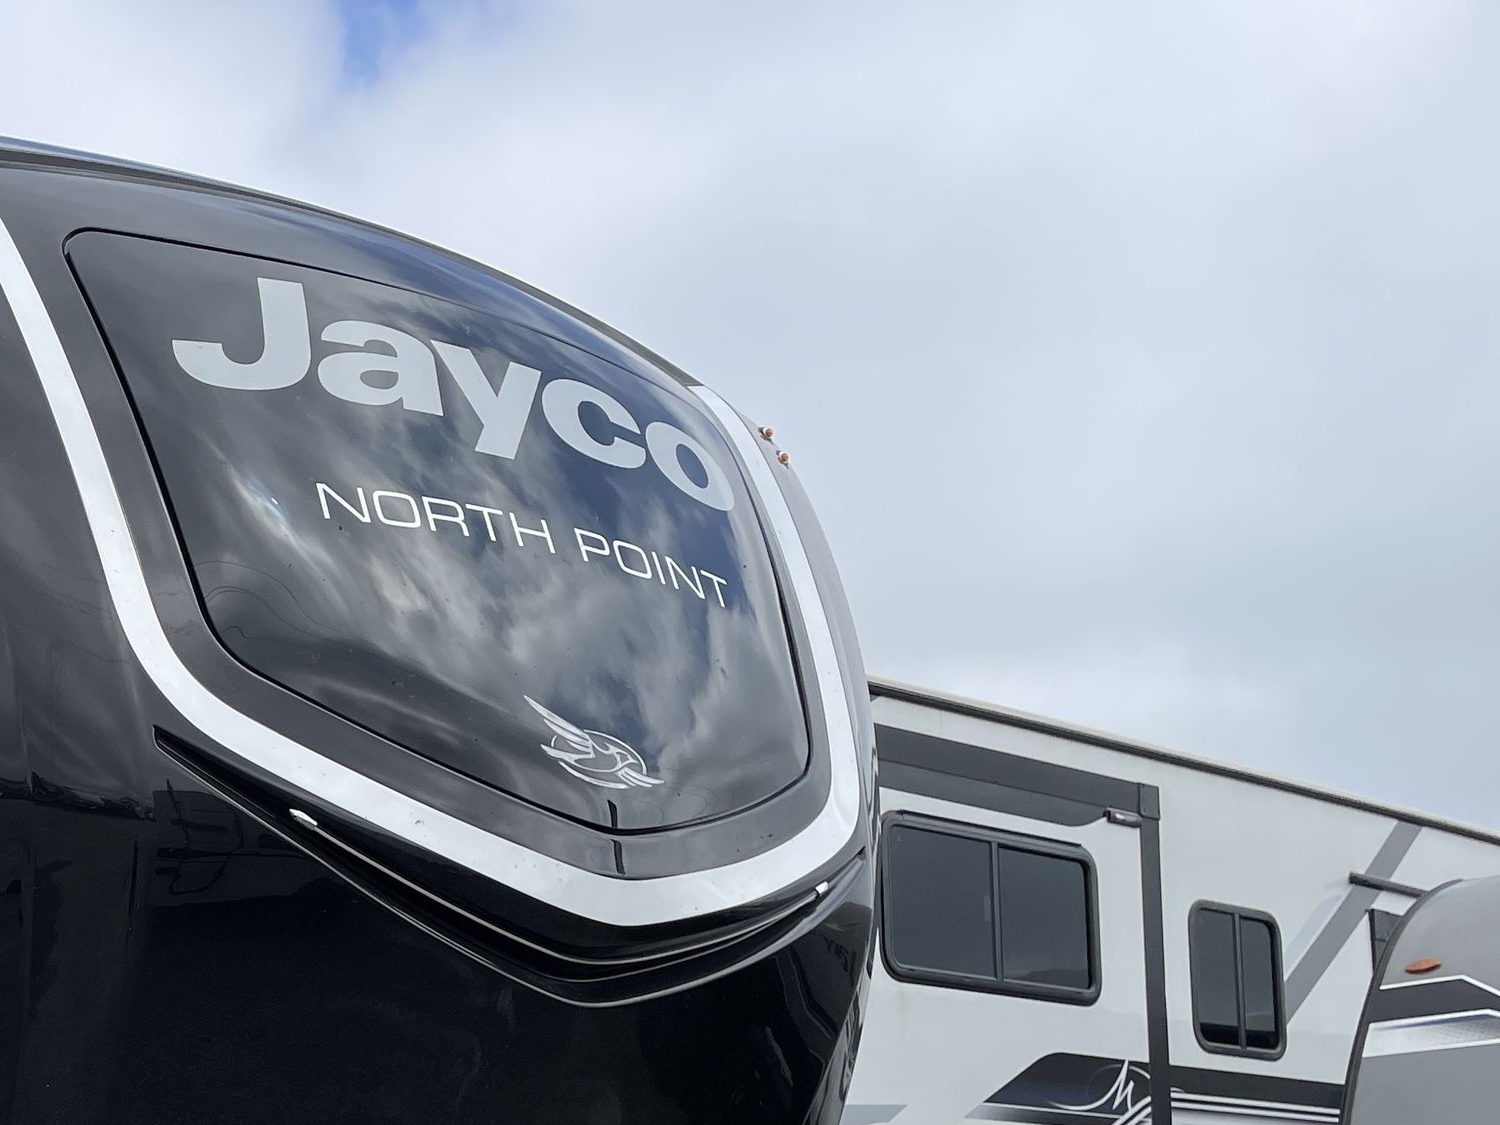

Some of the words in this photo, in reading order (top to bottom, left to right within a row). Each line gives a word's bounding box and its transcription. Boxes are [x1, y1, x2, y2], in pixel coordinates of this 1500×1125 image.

[171, 277, 735, 512] Jayco
[315, 482, 555, 554] NORTH
[573, 526, 727, 608] POINT
